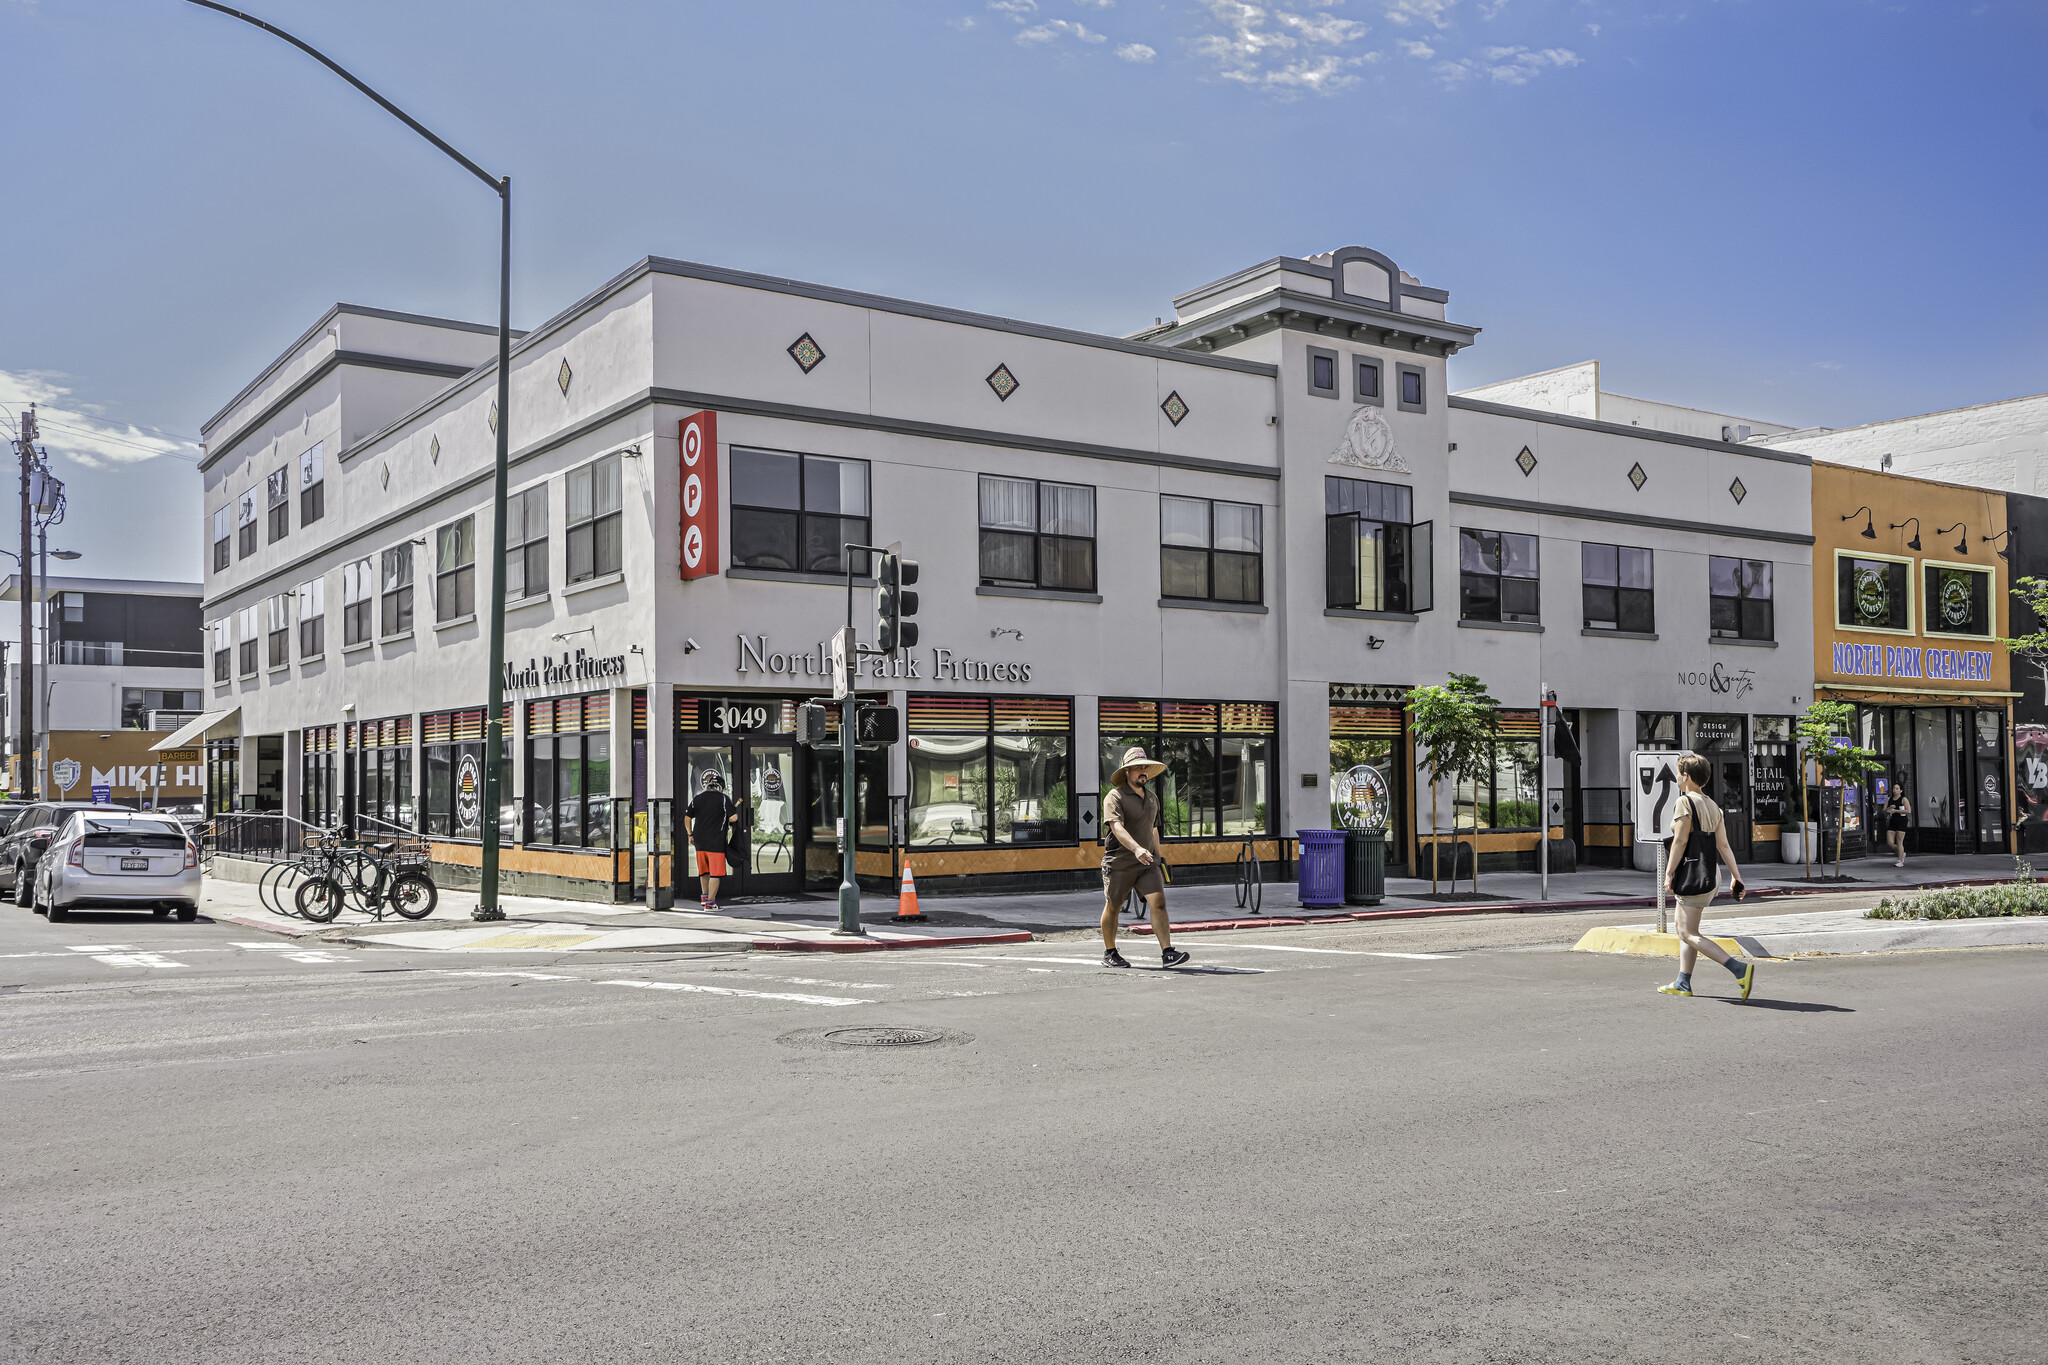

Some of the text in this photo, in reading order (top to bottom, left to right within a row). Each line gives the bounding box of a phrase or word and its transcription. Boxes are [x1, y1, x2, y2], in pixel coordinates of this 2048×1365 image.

[1861, 600, 1881, 612] FITNESS
[1946, 608, 1965, 619] FITNESS
[737, 634, 1033, 682] North Park Fitness
[1833, 642, 1993, 682] NORTH PARK CREAMERY
[504, 648, 625, 690] North Park Fitness
[714, 706, 767, 729] 3049
[91, 766, 167, 786] MIKE
[1756, 768, 1784, 778] ETAIL
[1341, 773, 1363, 796] NORTH
[1367, 774, 1383, 796] PARK
[1756, 782, 1784, 791] HERAPY
[460, 800, 476, 819] FITNESS
[1343, 810, 1382, 828] FITNESS
